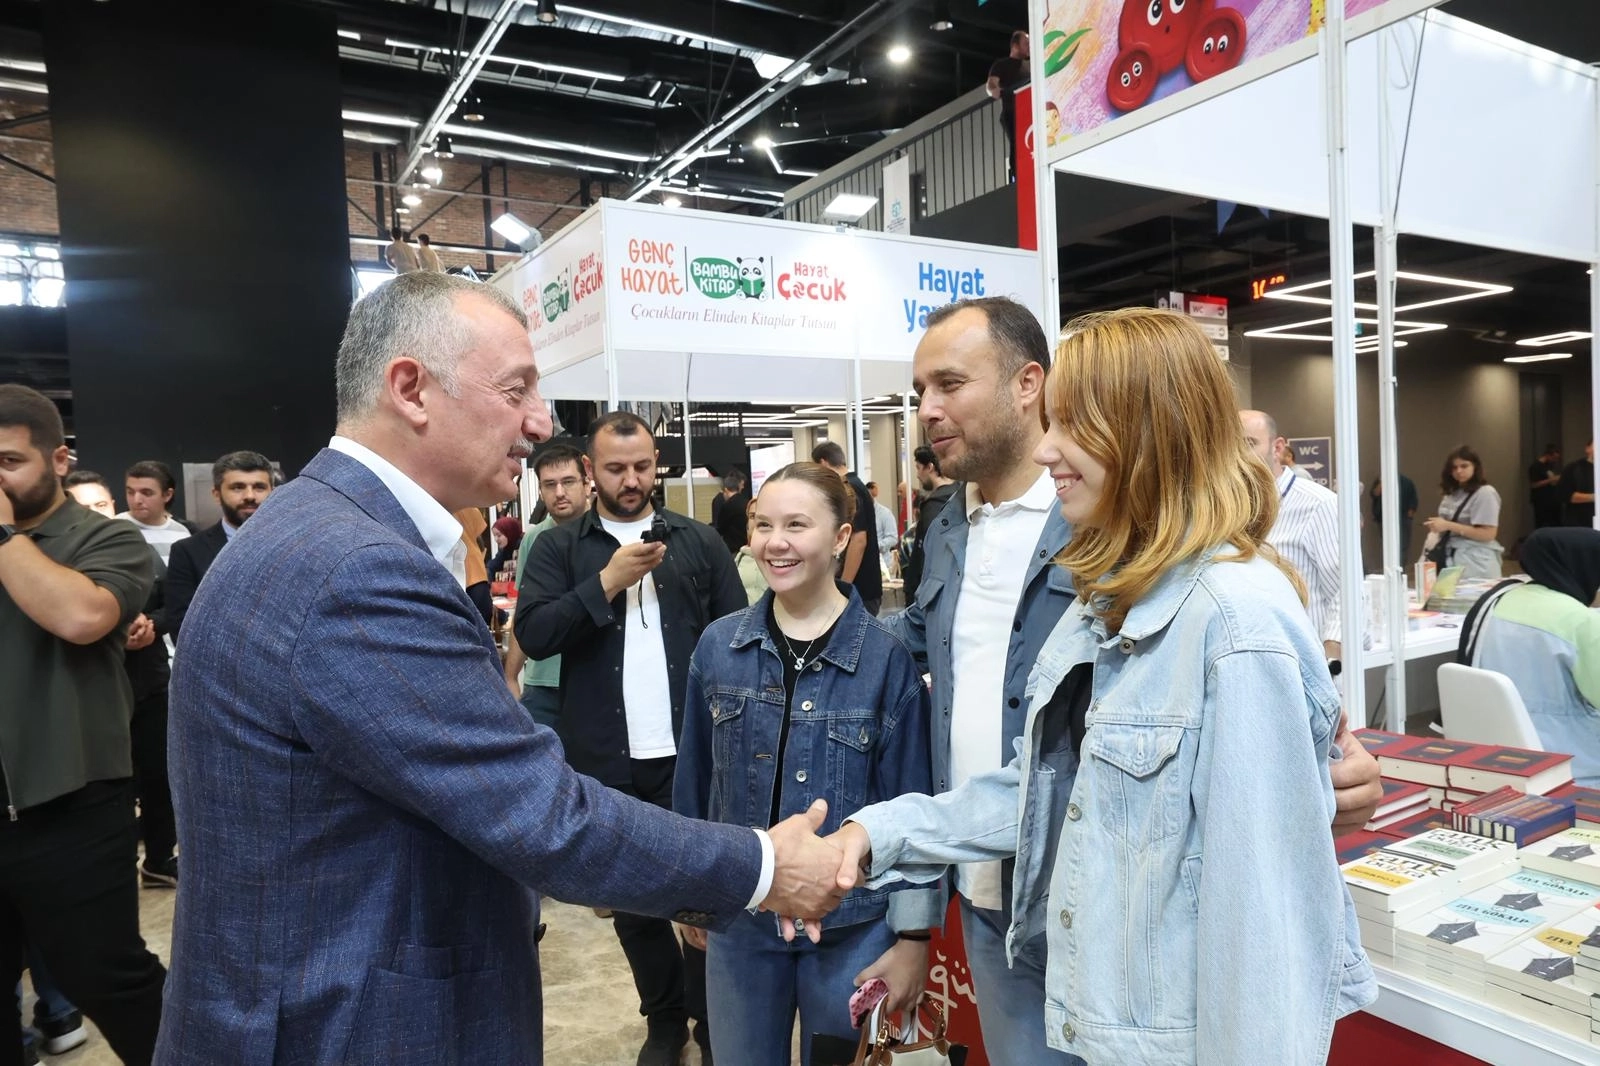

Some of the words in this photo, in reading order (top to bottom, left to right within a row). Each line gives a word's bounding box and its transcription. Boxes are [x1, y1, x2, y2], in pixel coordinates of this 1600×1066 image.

[692, 261, 738, 280] BAMBU
[793, 262, 829, 278] Hayat
[700, 278, 736, 294] KİTAP
[919, 262, 985, 303] Hayat
[631, 303, 699, 321] Çocukların
[703, 307, 748, 325] Elinden
[751, 311, 797, 330] Kitaplar
[1298, 445, 1320, 456] WC
